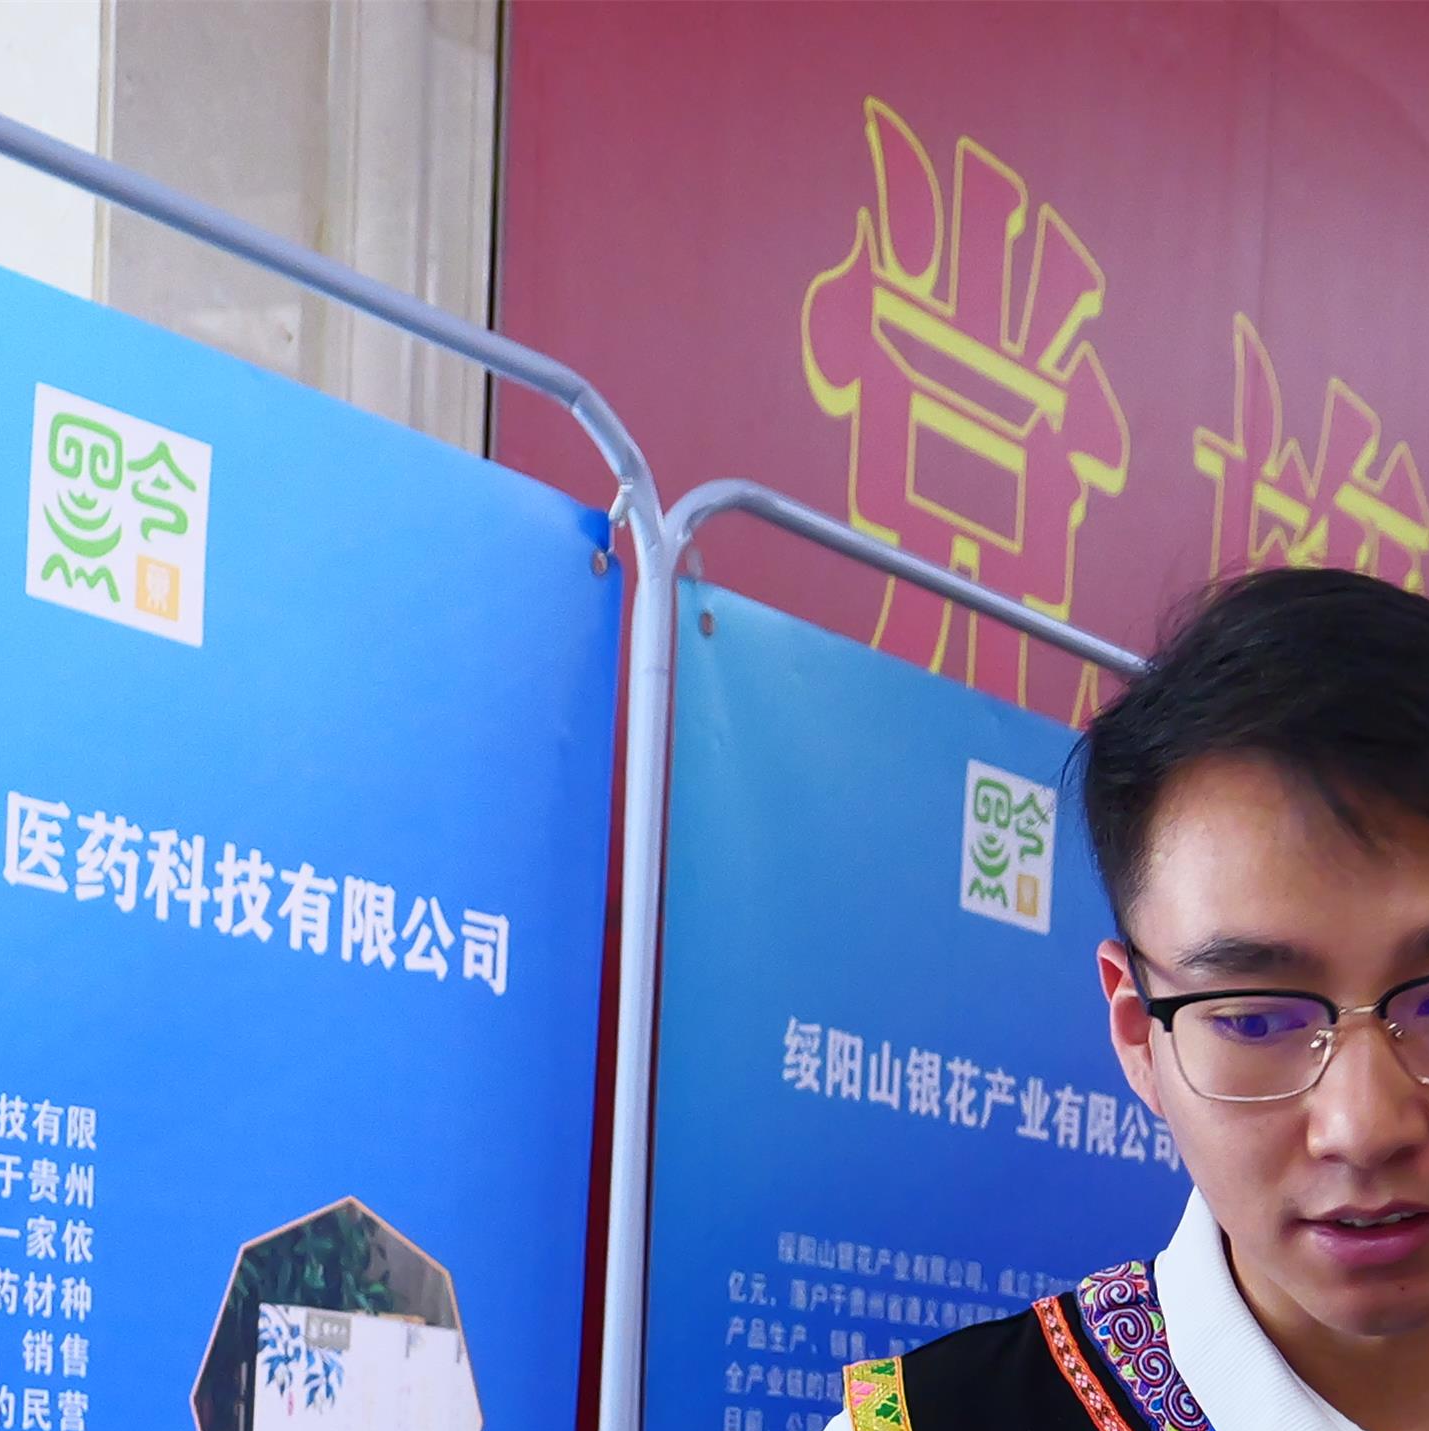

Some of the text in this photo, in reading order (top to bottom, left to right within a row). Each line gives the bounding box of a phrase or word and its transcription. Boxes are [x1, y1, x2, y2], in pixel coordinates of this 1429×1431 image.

[782, 1015, 1181, 1171] 绥阳山银花产业有限公司
